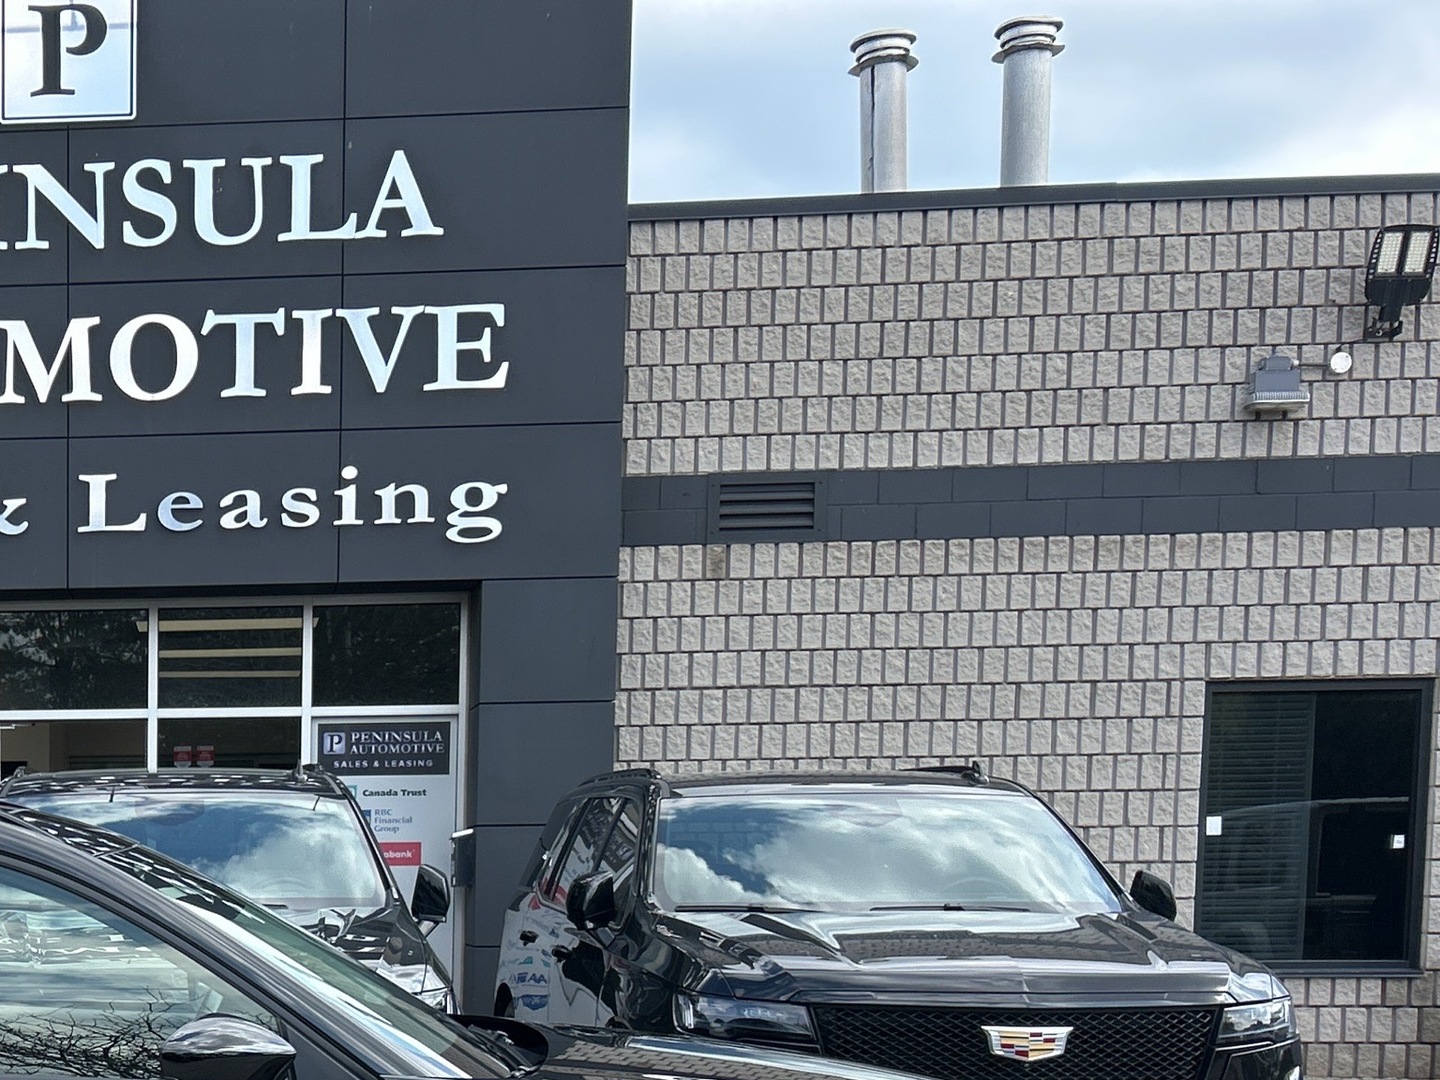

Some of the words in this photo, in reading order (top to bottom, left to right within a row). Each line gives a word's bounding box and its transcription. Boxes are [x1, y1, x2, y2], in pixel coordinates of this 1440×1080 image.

[28, 4, 107, 97] P
[77, 465, 508, 543] Leasing
[327, 734, 342, 752] P
[350, 731, 442, 743] PENINSULA
[349, 743, 444, 755] AUTOMOTIVE
[333, 760, 368, 769] SALES
[384, 760, 433, 768] LEASING
[363, 789, 398, 797] Canada
[401, 789, 427, 797] Trust
[374, 826, 400, 834] Group
[383, 850, 412, 858] abank
